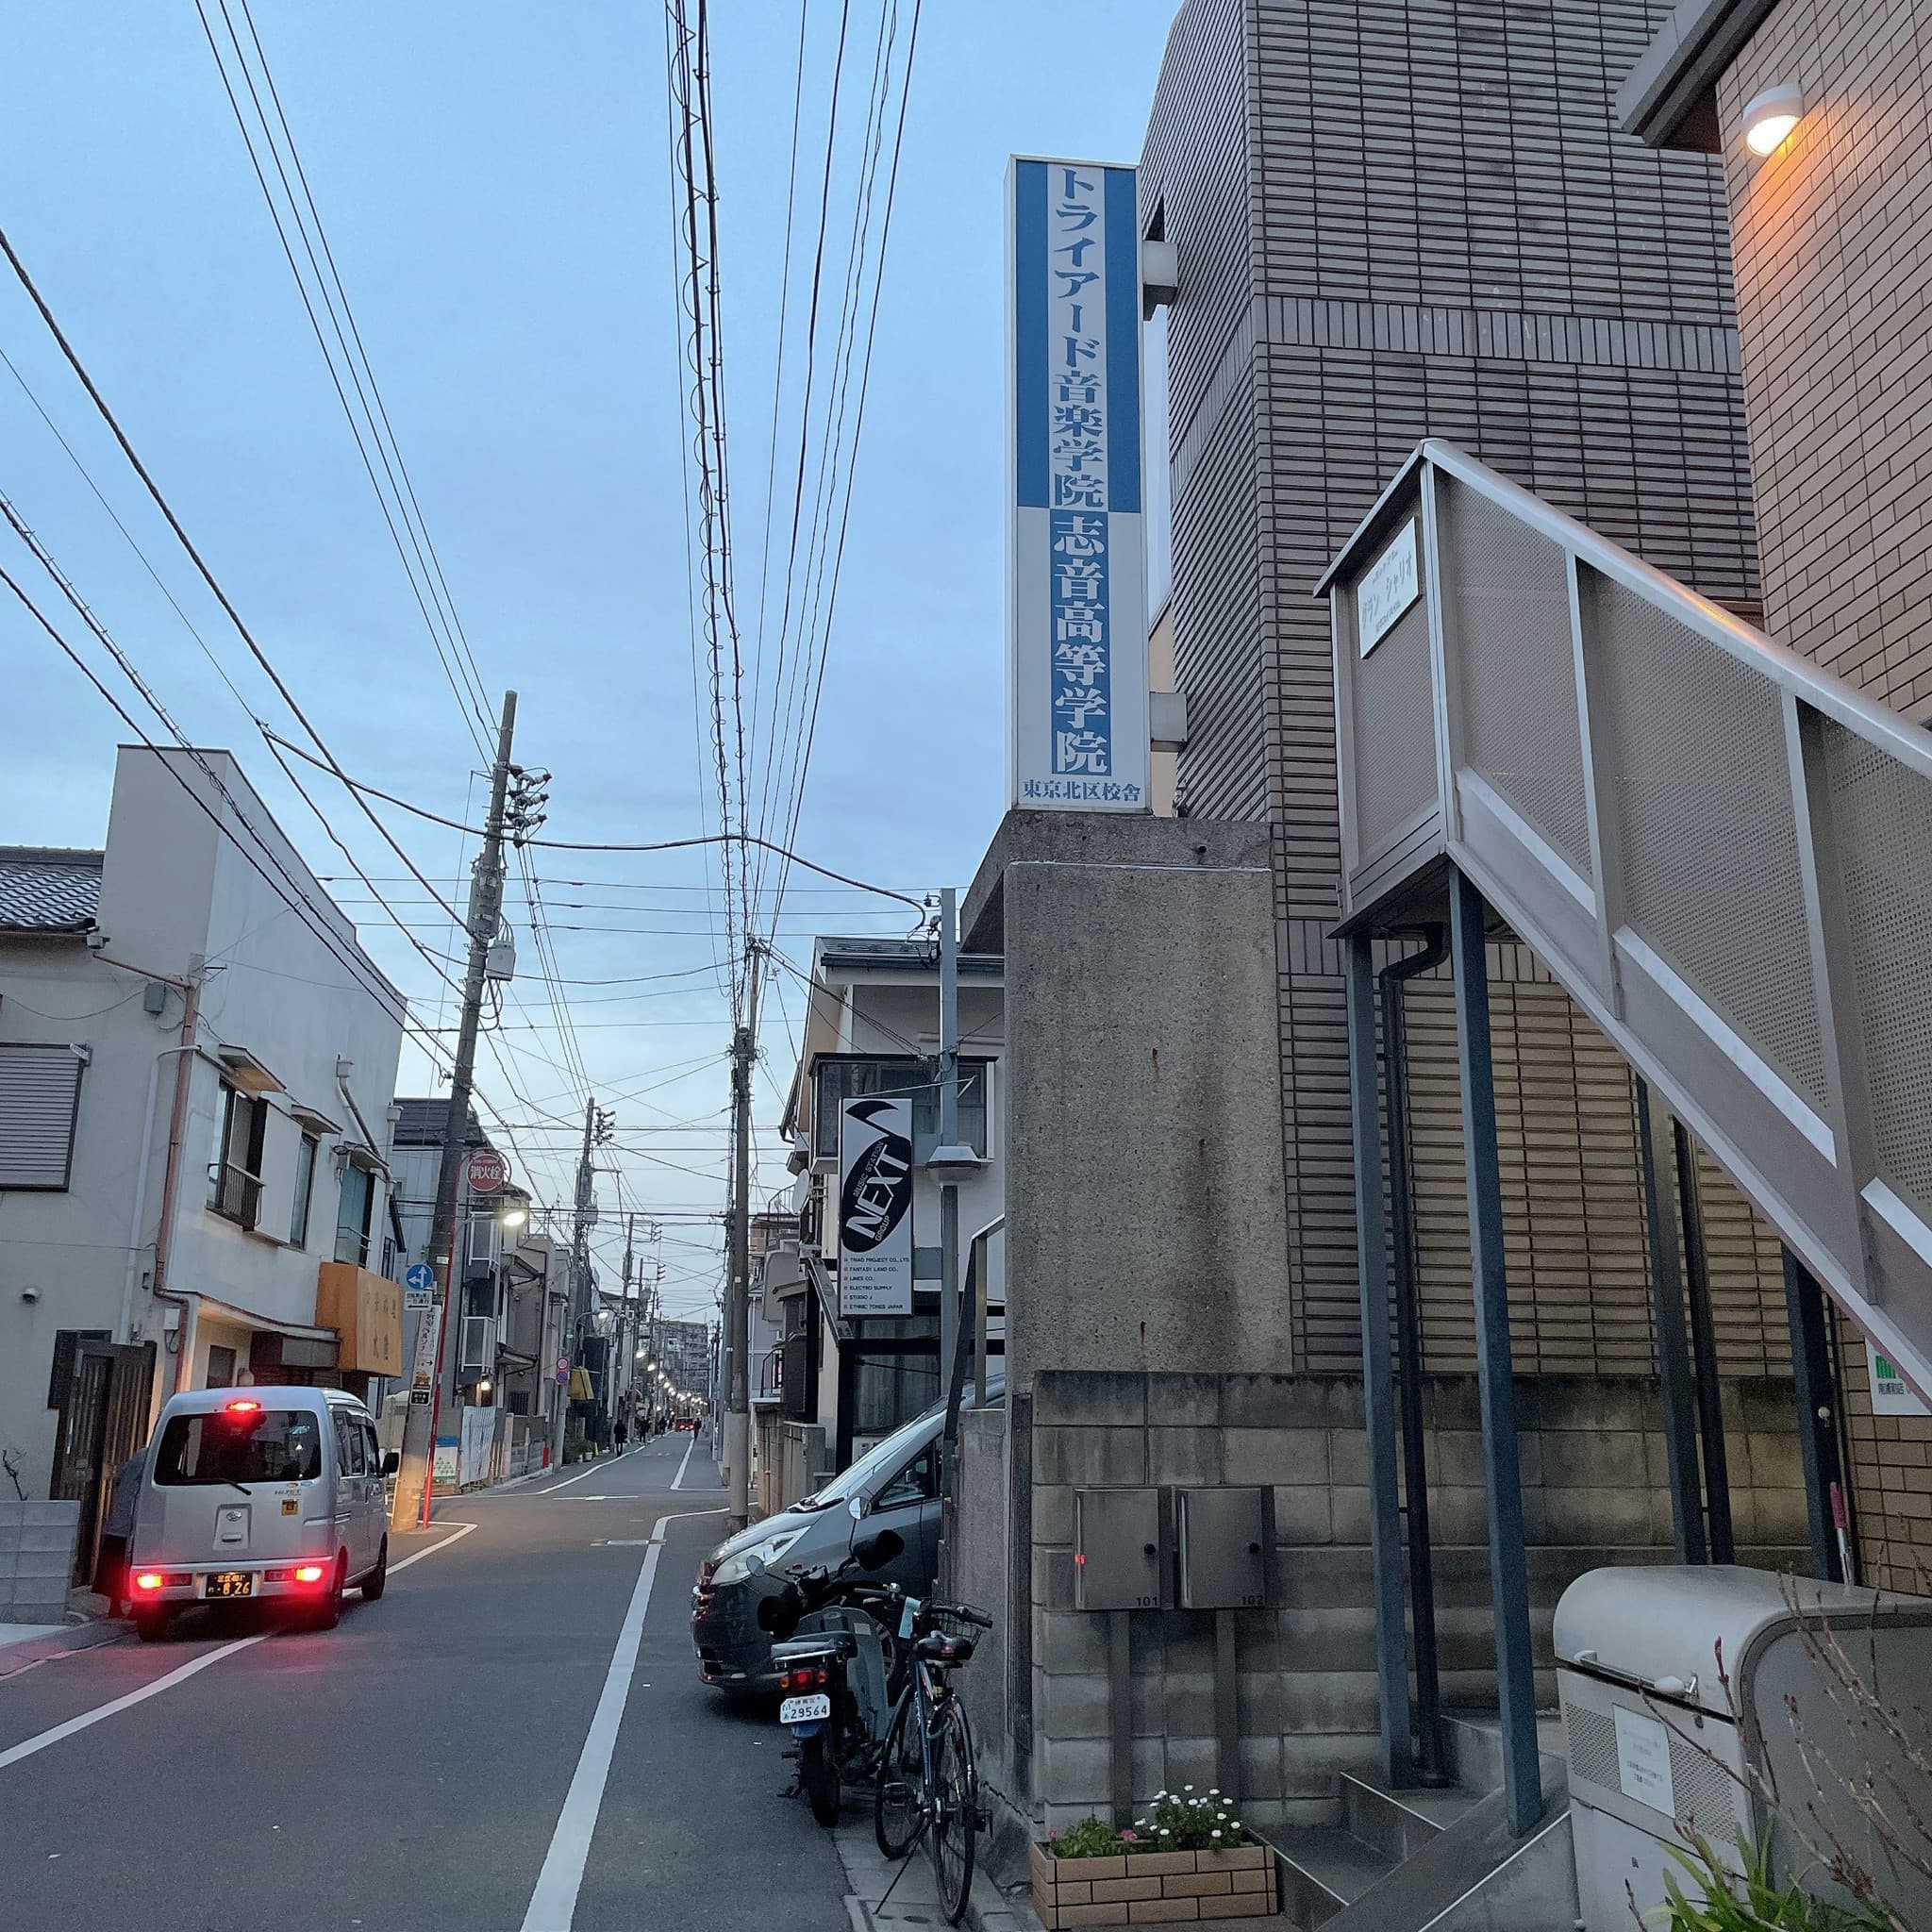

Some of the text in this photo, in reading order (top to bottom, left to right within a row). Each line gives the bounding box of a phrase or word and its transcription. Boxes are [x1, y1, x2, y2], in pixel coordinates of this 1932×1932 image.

[1053, 168, 1104, 508] トライアード音楽学院
[1054, 515, 1108, 774] 志音高等学院
[1023, 779, 1141, 802] 東京北区校舎
[471, 1165, 501, 1179] 消火栓
[853, 1141, 884, 1197] MUSIC STATION
[845, 1143, 909, 1240] NEXT
[874, 1215, 891, 1241] GROUP
[1136, 1596, 1158, 1607] 101
[1241, 1595, 1263, 1606] 102
[791, 1705, 827, 1719] 29564
